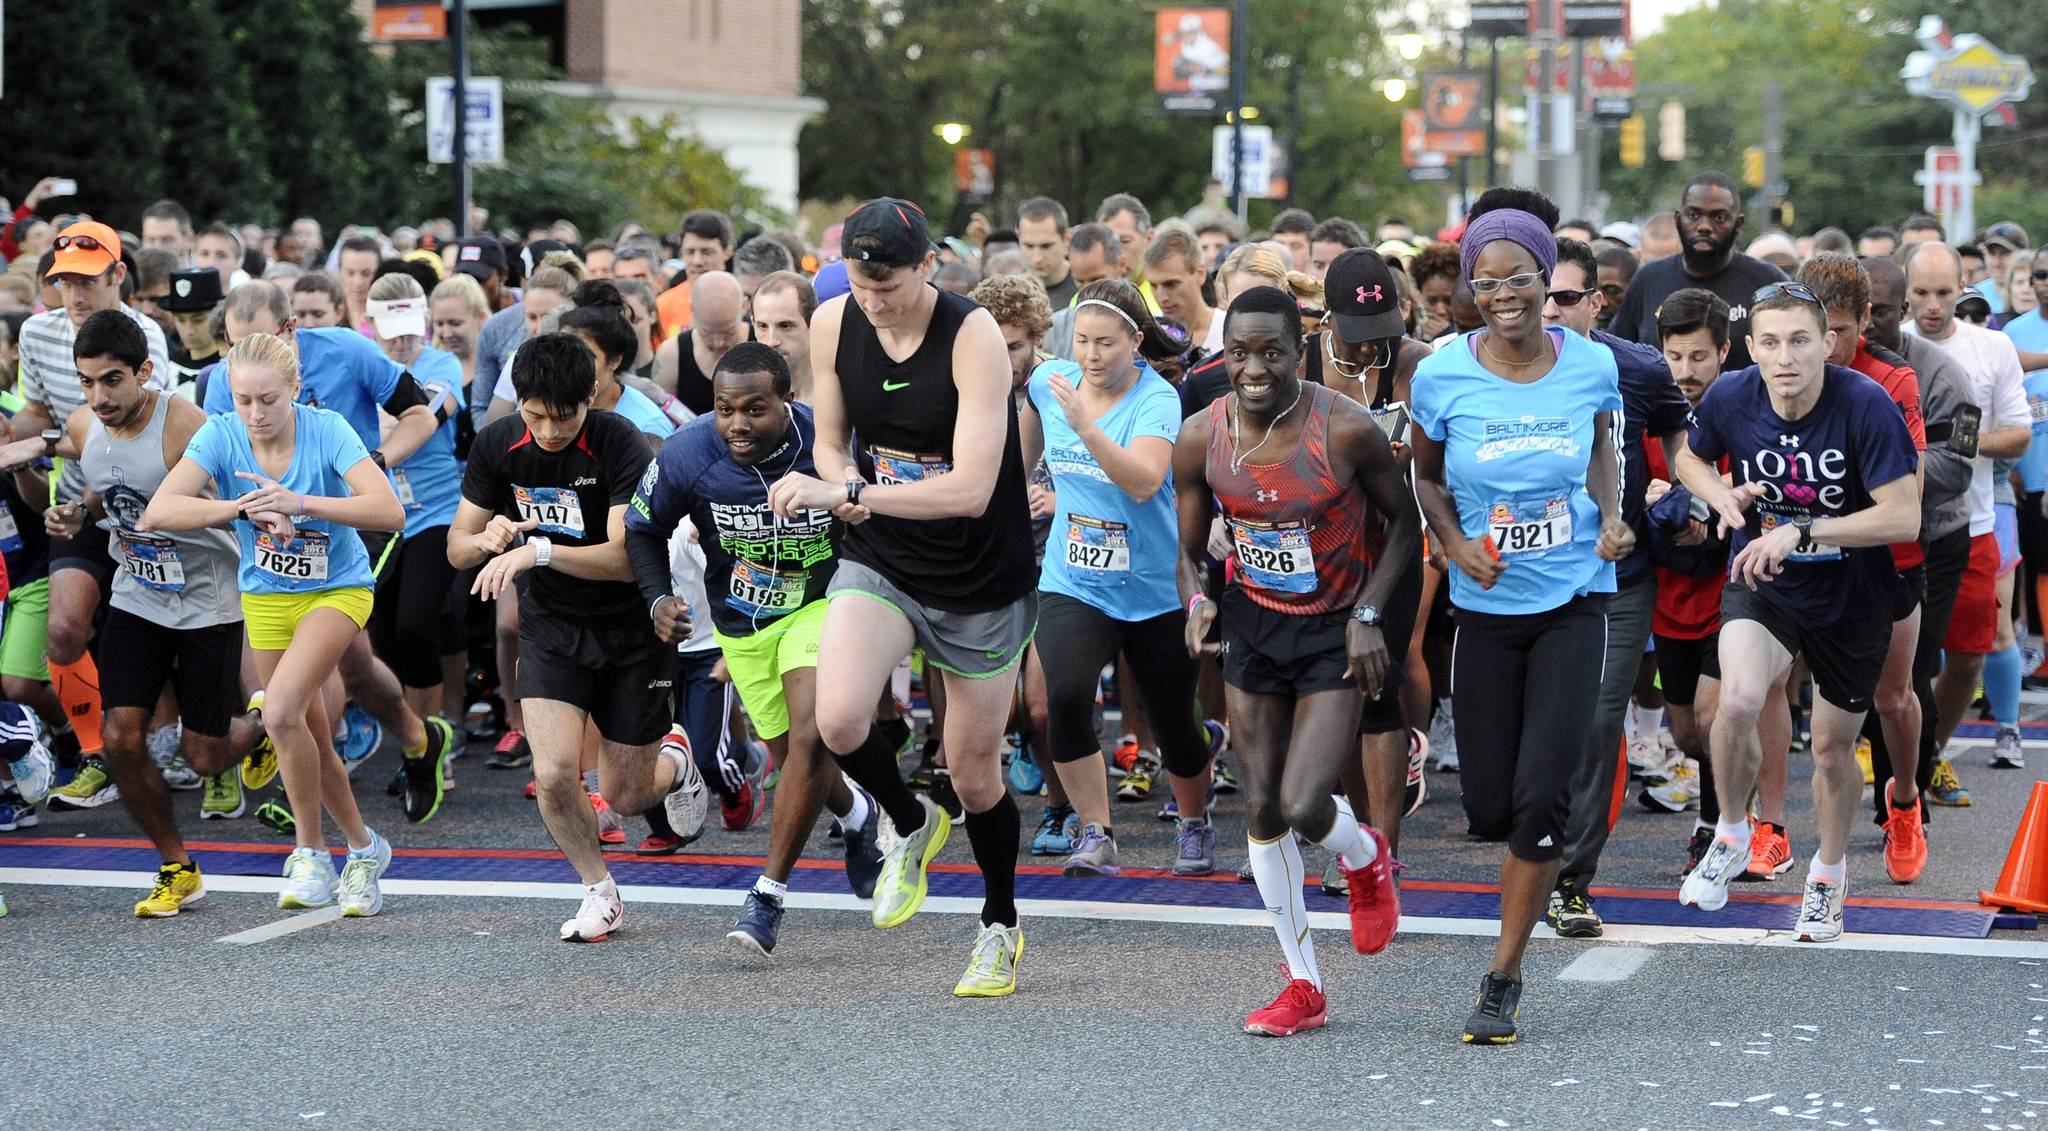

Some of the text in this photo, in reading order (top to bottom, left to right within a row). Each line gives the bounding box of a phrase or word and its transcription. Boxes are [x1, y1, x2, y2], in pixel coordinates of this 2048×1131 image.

[1487, 422, 1569, 435] BALTIMORE
[1051, 448, 1095, 461] BALTIMO
[1756, 449, 1846, 482] one
[519, 502, 568, 524] 7147
[710, 502, 771, 514] BALTIMO
[717, 521, 833, 539] DEPARTMENT
[1494, 521, 1554, 550] 7921
[259, 550, 312, 577] 7625
[1069, 543, 1114, 568] 8427
[1240, 544, 1295, 573] 6326
[127, 556, 167, 582] 5781
[733, 578, 787, 606] 6193
